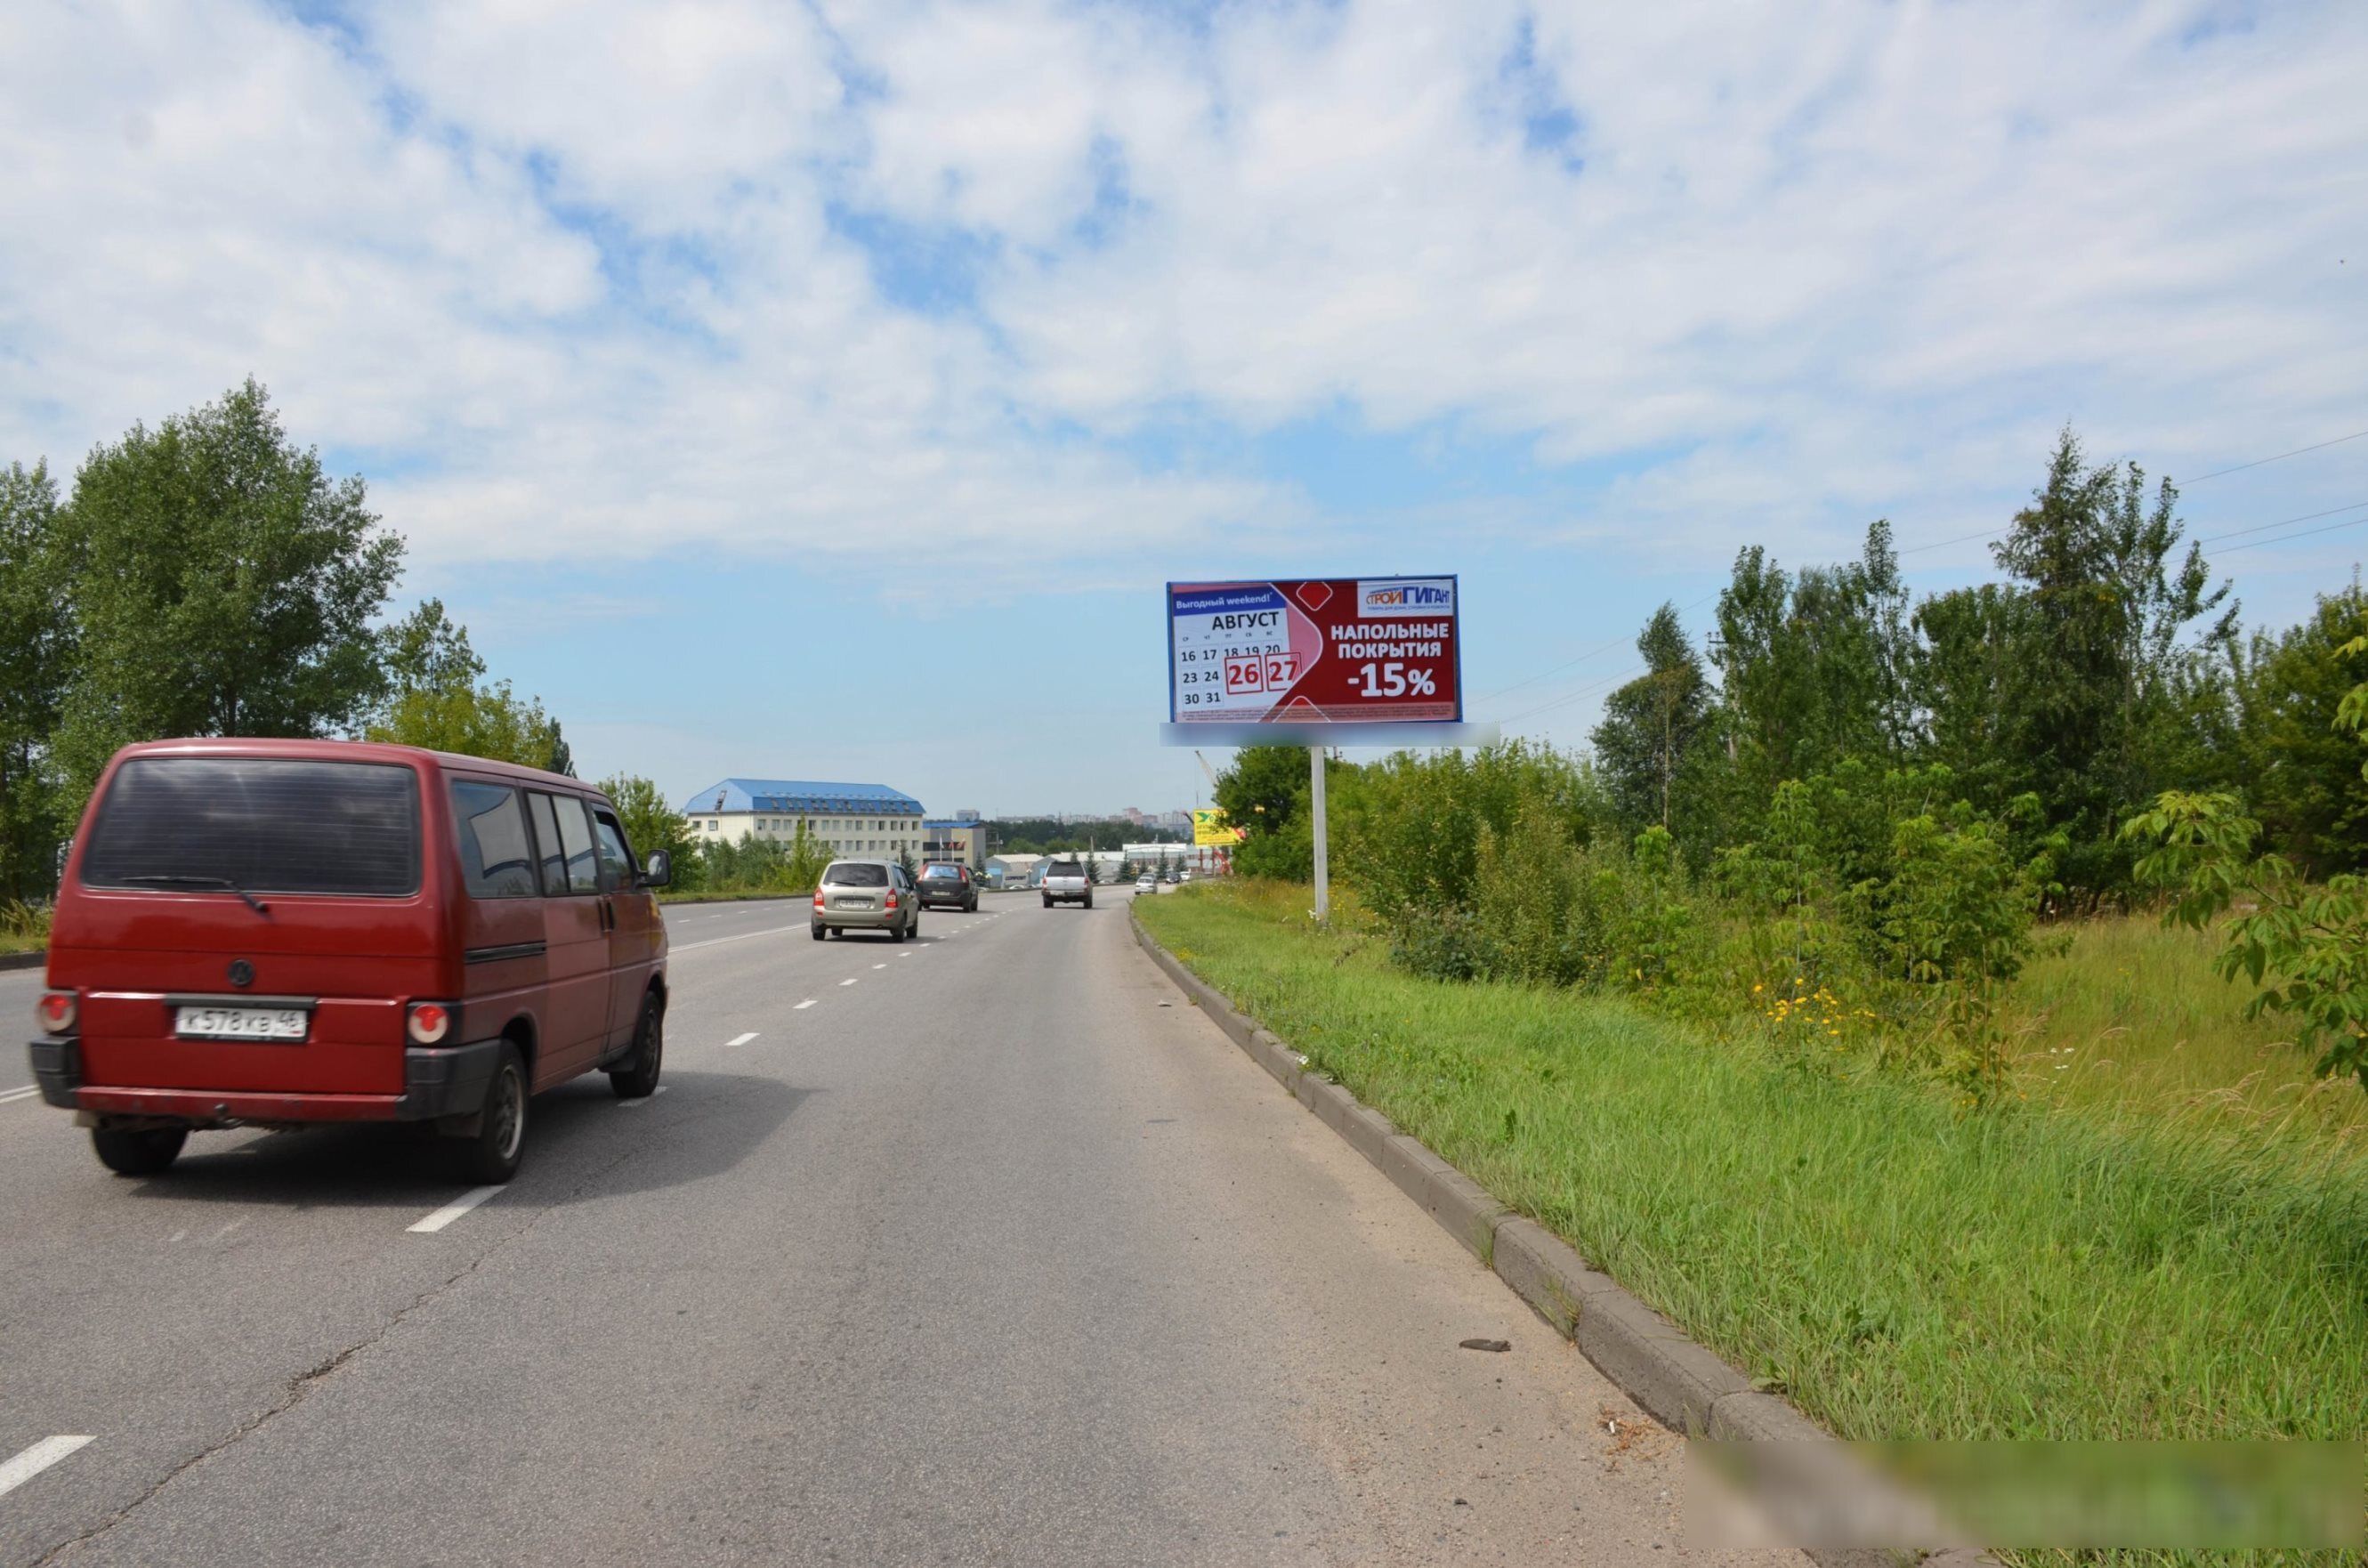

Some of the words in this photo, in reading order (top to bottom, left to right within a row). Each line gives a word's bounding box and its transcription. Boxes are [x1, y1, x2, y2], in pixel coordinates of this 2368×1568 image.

[1176, 597, 1225, 610] Выгодный
[1211, 611, 1280, 631] АВГУСТ
[1331, 623, 1449, 640] НАПОЛЬНЫЕ
[1182, 651, 1196, 662] 16
[1203, 650, 1217, 660] 17
[1224, 648, 1239, 657] 18
[1246, 646, 1259, 655] 19
[1265, 644, 1281, 654] 20
[1338, 642, 1442, 659] ПОКРЫТИЯ
[1184, 673, 1198, 683] 23
[1204, 671, 1219, 682] 24
[1229, 664, 1259, 685] 26
[1269, 660, 1298, 682] 27
[1347, 662, 1435, 697] -15%
[1184, 693, 1200, 705] 30
[1206, 692, 1221, 703] 31
